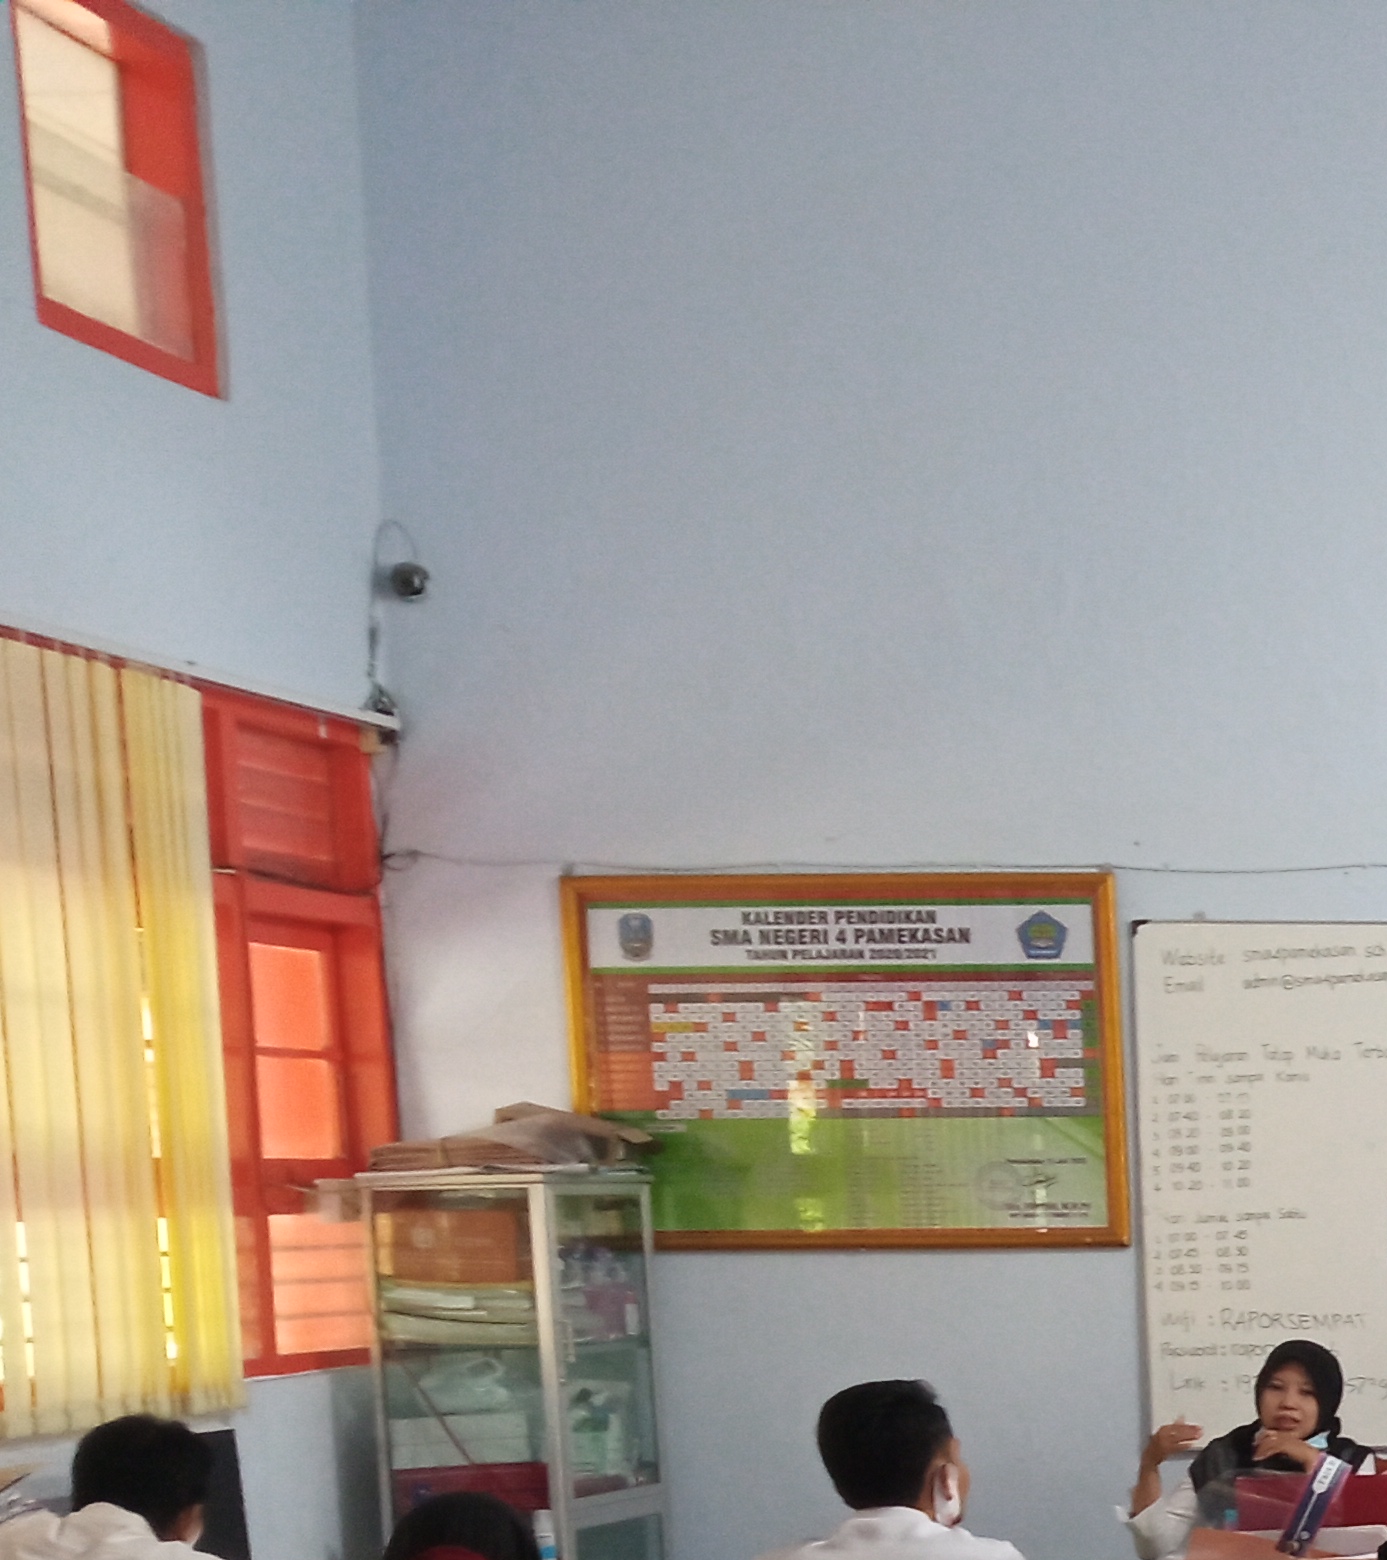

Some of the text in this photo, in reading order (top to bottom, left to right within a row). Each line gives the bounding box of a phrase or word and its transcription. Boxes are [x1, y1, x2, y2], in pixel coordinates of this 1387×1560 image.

[741, 910, 937, 925] KALENDER PENDIDIKAN
[709, 927, 972, 946] SMA NEGERI 4 PAMEKASAN
[746, 949, 789, 961] TAHUN
[792, 949, 865, 960] PELAJARAN
[1219, 1307, 1369, 1331] RAPORSEMPAT
